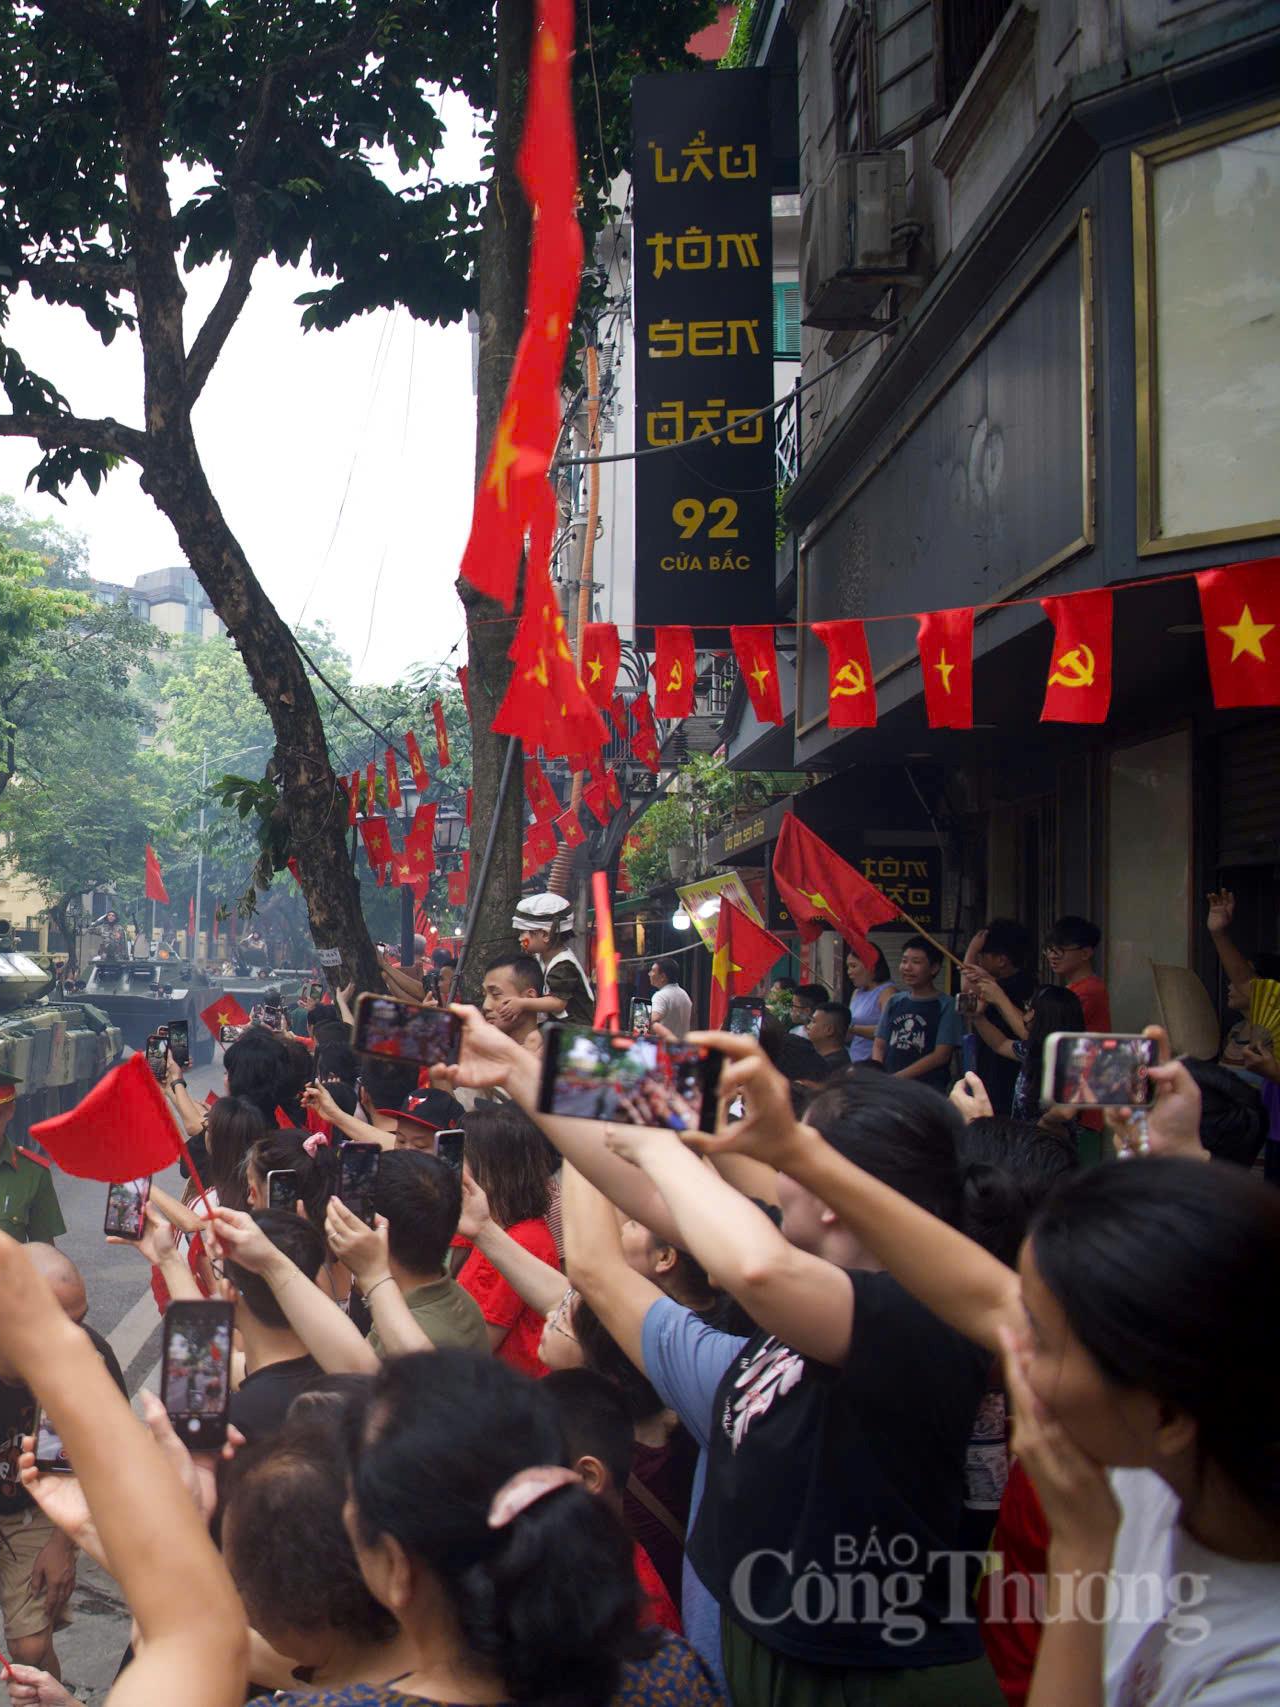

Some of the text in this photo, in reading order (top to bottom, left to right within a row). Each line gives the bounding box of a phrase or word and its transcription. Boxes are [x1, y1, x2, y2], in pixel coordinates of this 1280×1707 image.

[646, 226, 760, 279] TÔM
[649, 319, 760, 358] SEN
[672, 498, 738, 539] 92
[709, 549, 750, 570] BẮC
